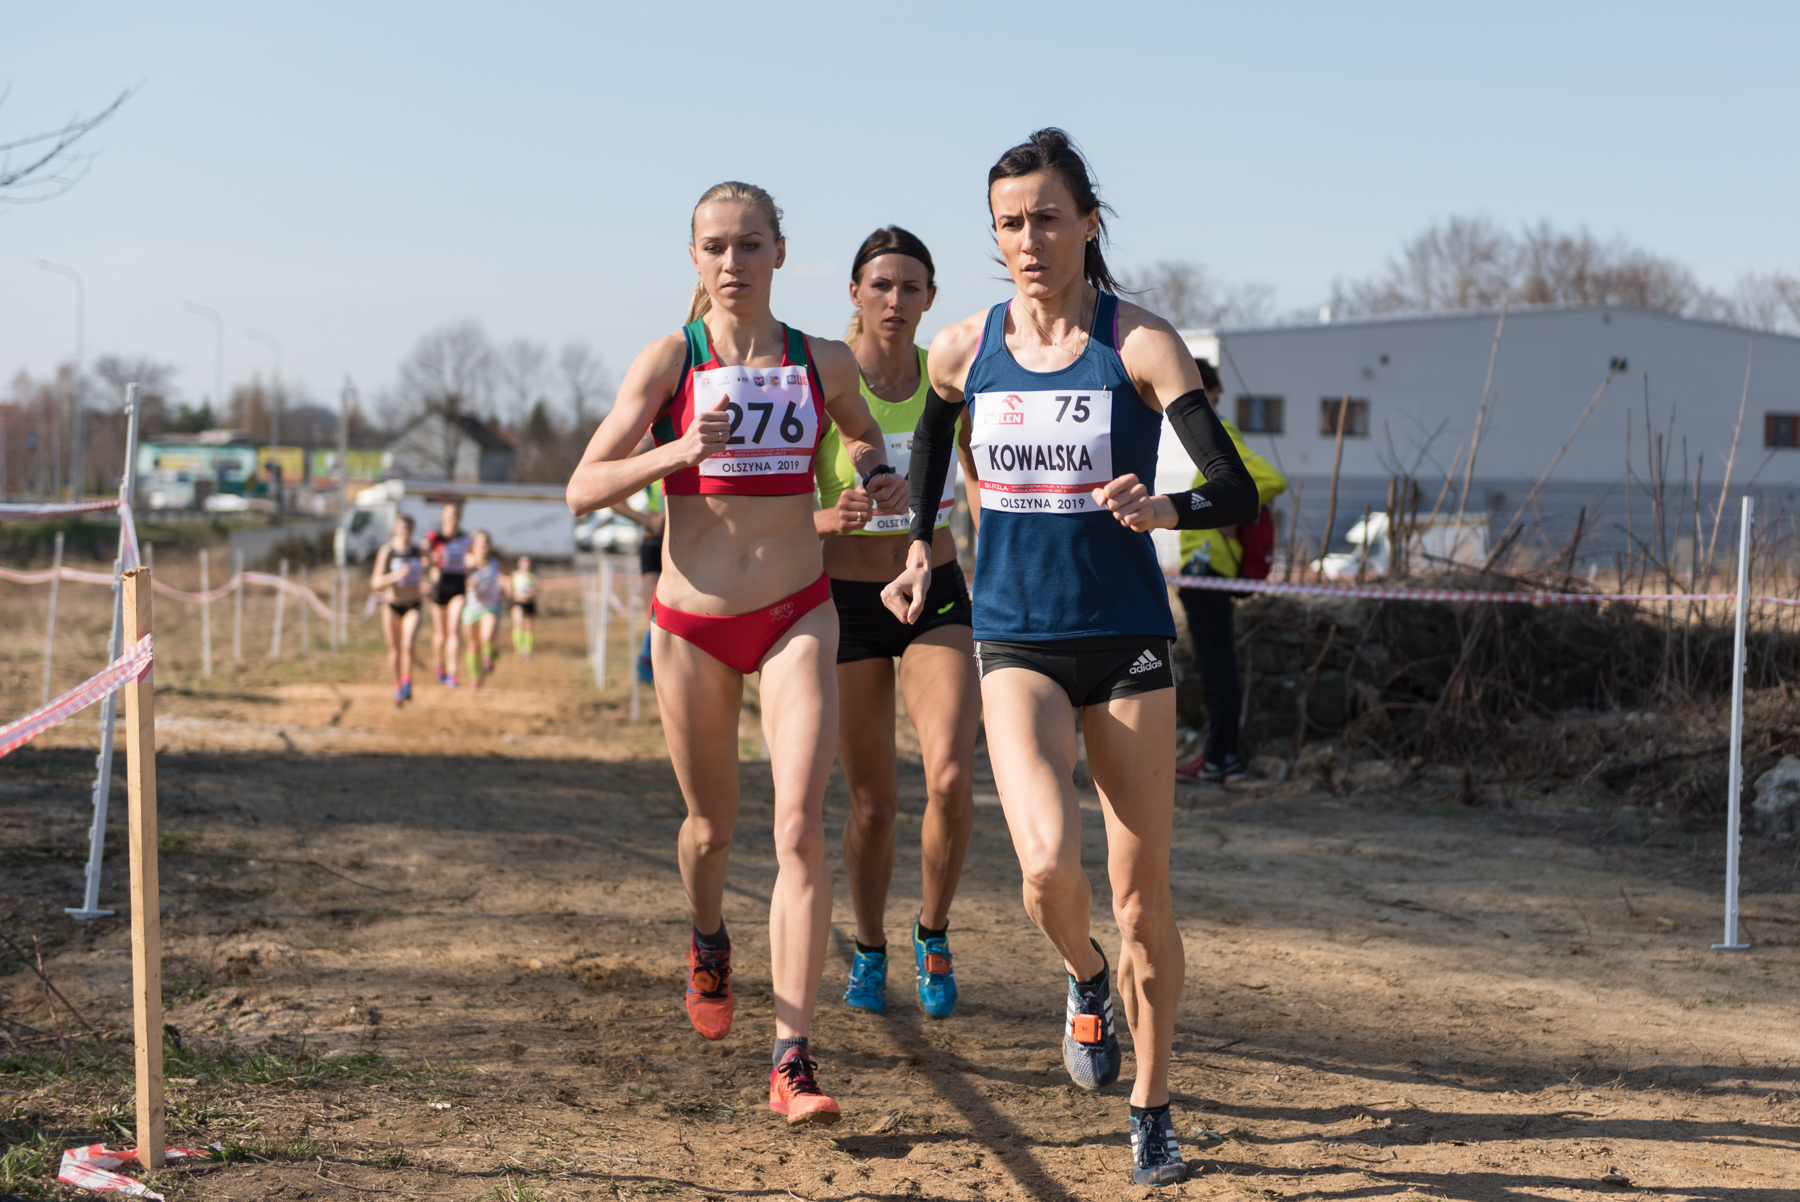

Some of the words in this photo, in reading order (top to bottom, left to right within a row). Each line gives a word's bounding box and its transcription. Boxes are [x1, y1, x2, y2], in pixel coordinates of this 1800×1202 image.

[1055, 396, 1090, 423] 75
[725, 401, 804, 445] 276
[988, 444, 1093, 471] KOWALSKA
[722, 461, 772, 473] OLSZYNA
[777, 460, 800, 471] 2019
[1000, 498, 1052, 509] OLSZYNA
[1058, 498, 1085, 510] 2019
[1191, 501, 1212, 511] adidas
[877, 516, 910, 529] OLSZYN
[1129, 660, 1163, 674] adidas
